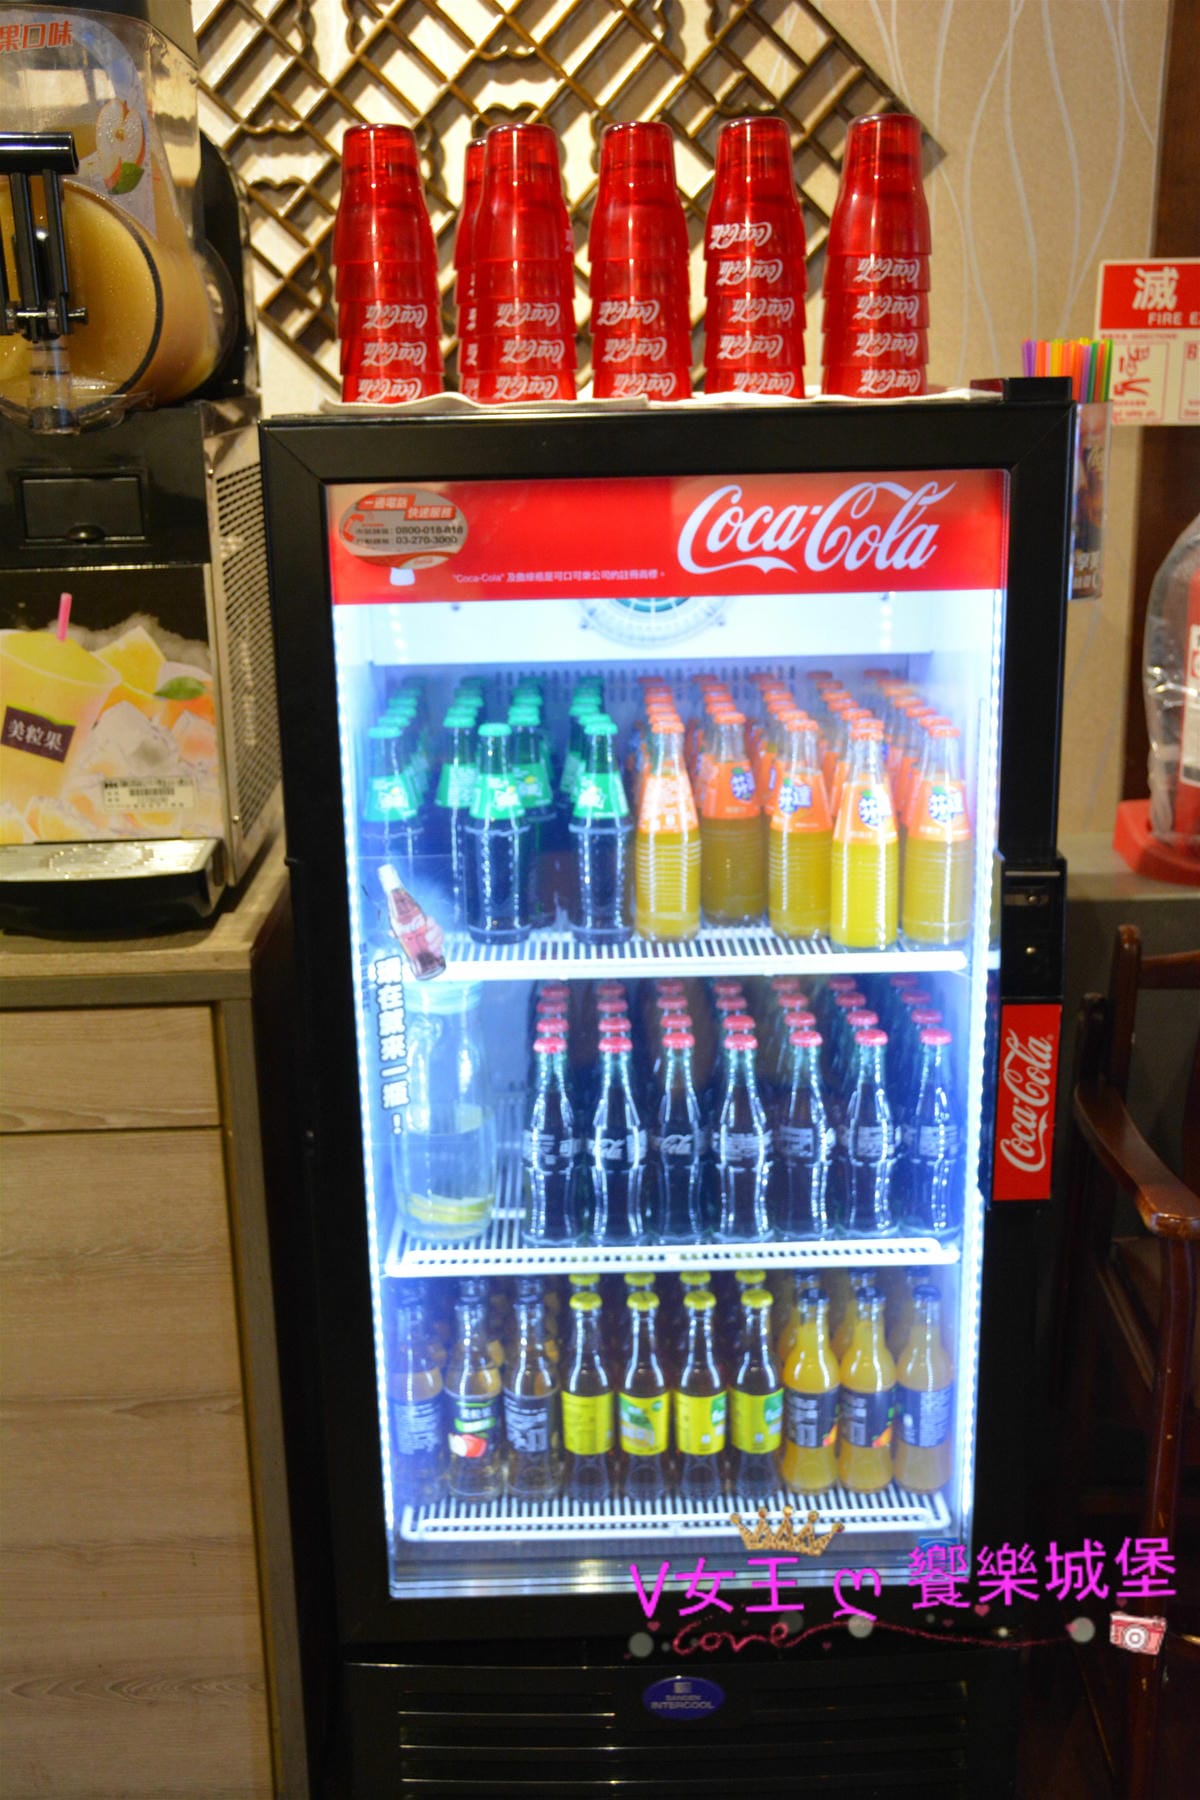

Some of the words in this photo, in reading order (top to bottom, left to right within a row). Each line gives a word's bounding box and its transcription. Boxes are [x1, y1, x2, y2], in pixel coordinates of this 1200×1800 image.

[0, 20, 73, 51] 果口味
[1132, 266, 1179, 310] 滅
[1148, 311, 1183, 326] FIRE
[1190, 311, 1200, 326] E
[677, 481, 957, 574] Coca-Cola
[8, 718, 64, 751] 美粒果
[1000, 1027, 1053, 1172] Coca-Cola
